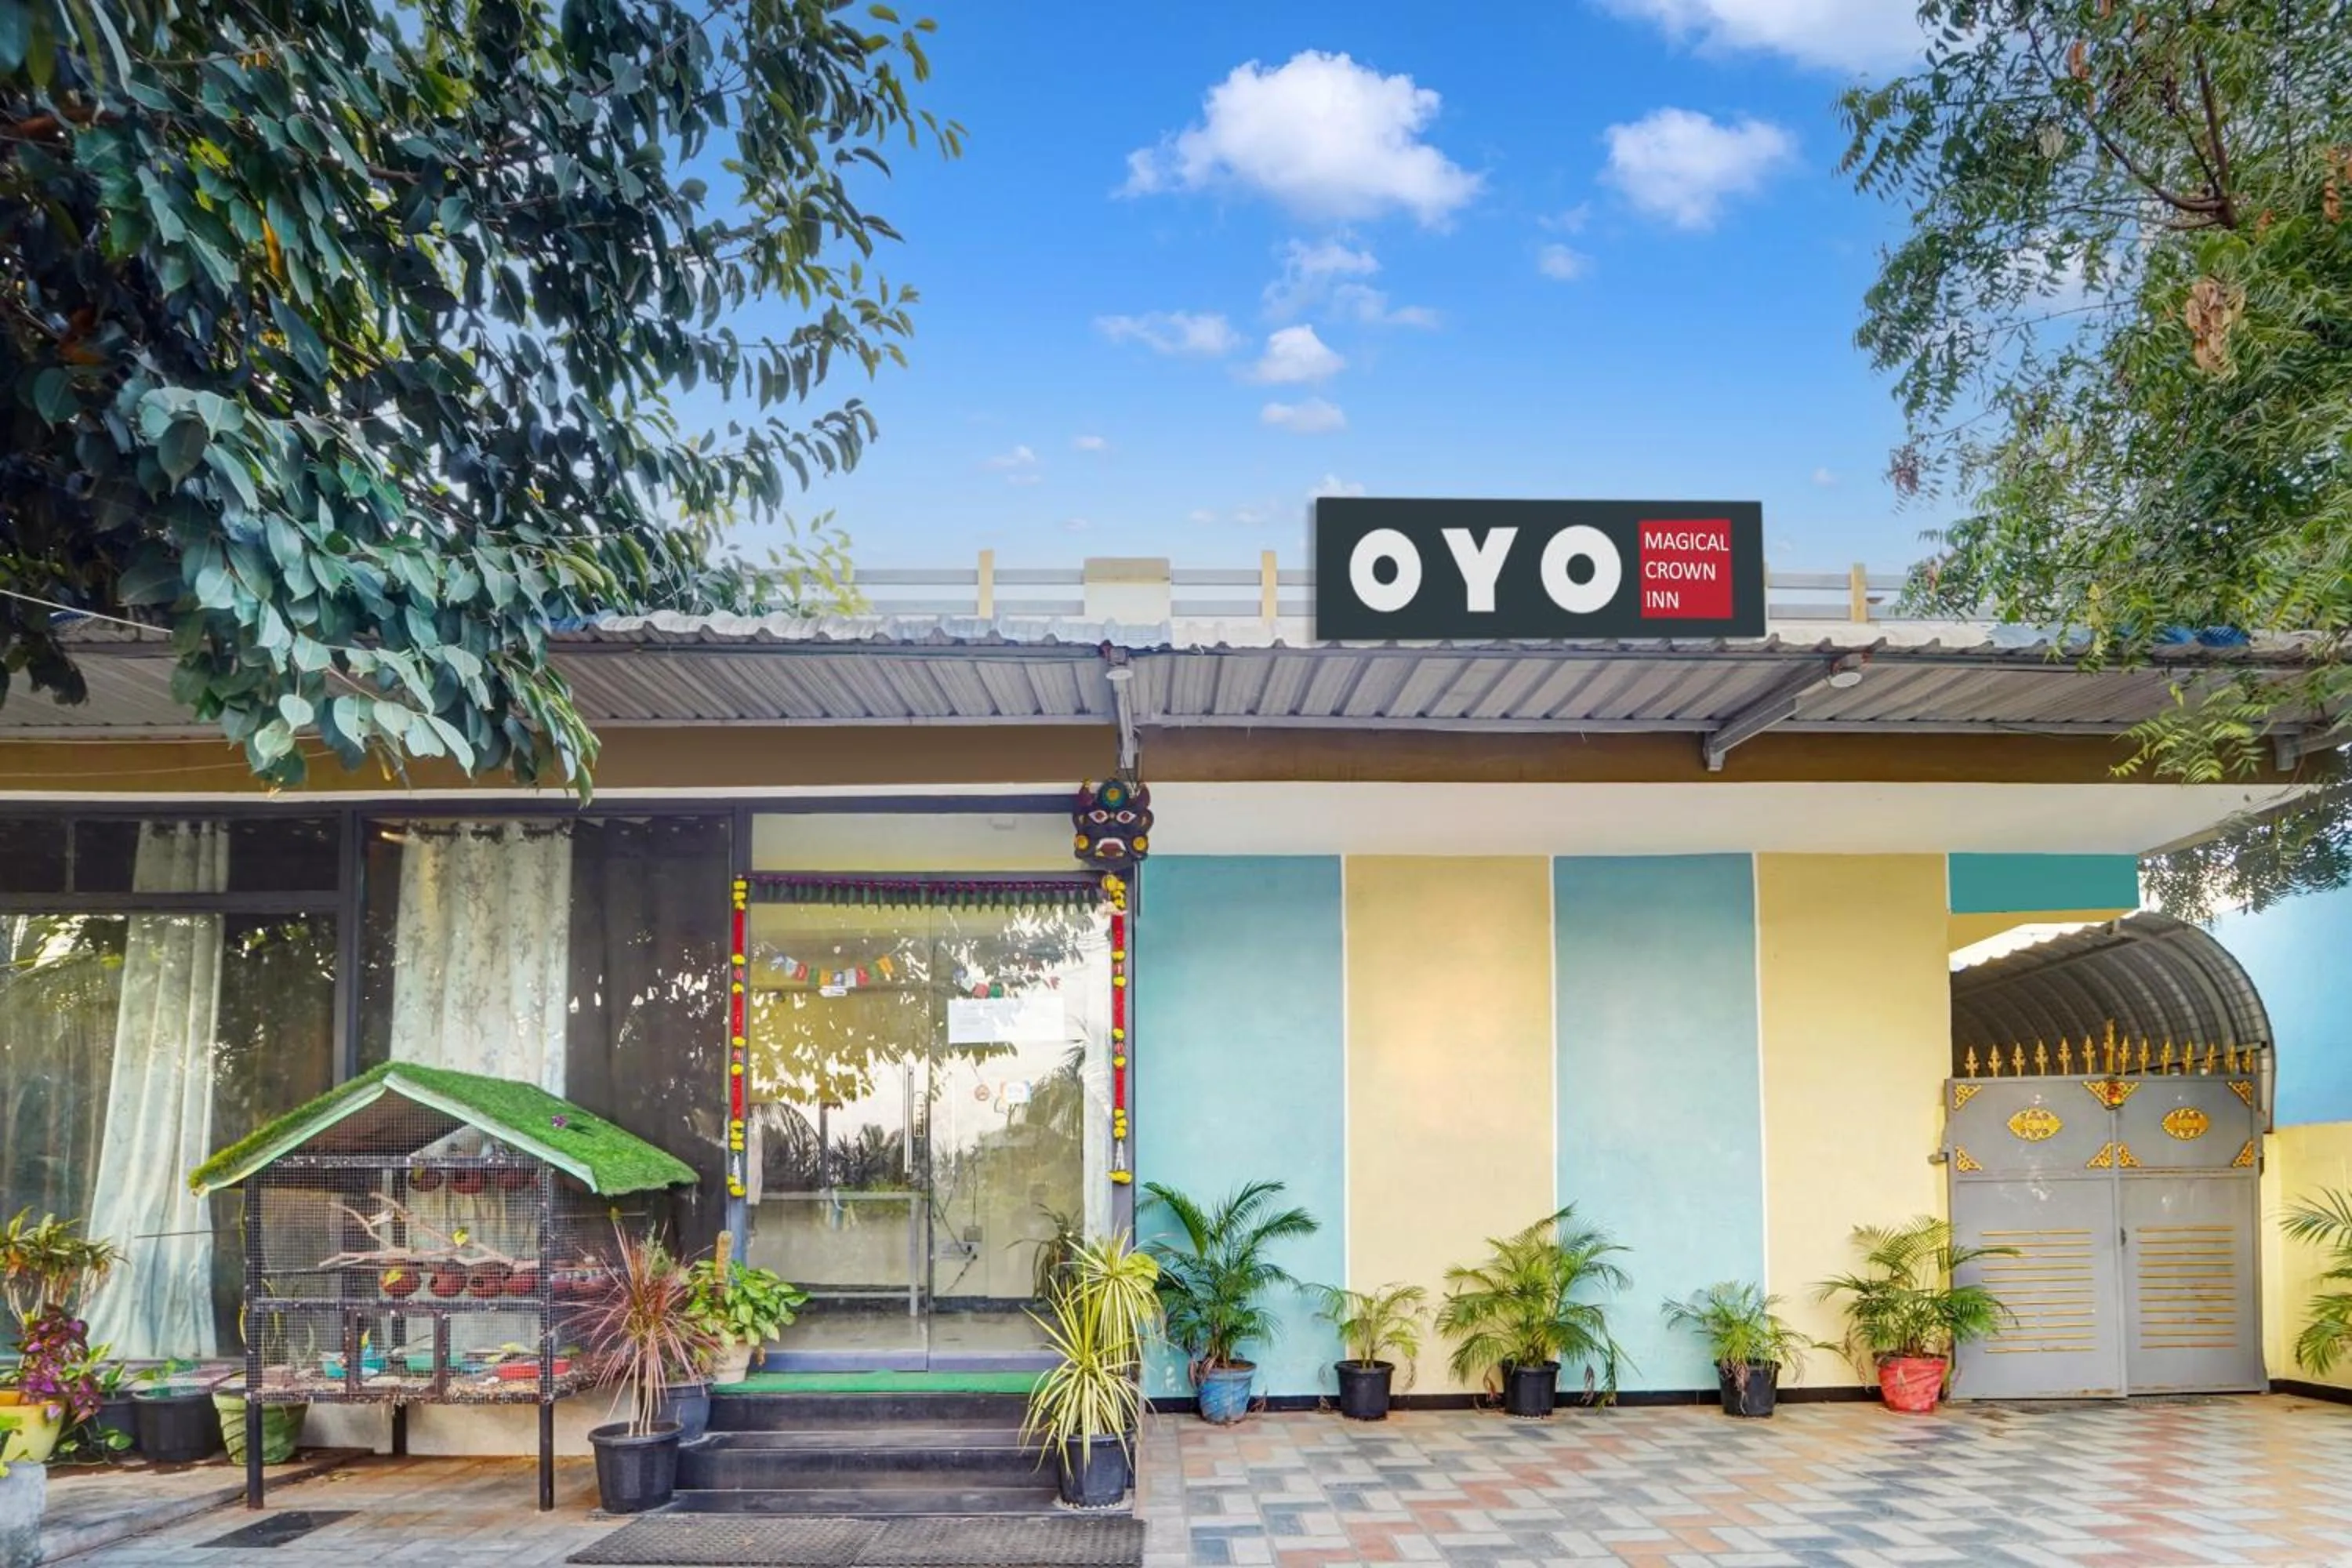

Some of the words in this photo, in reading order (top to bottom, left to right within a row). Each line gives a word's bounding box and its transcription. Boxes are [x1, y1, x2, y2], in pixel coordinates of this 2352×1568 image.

[1645, 532, 1730, 551] MAGICAL
[1349, 524, 1622, 614] OYO
[1645, 561, 1716, 581] CROWN
[1646, 590, 1679, 609] INN
